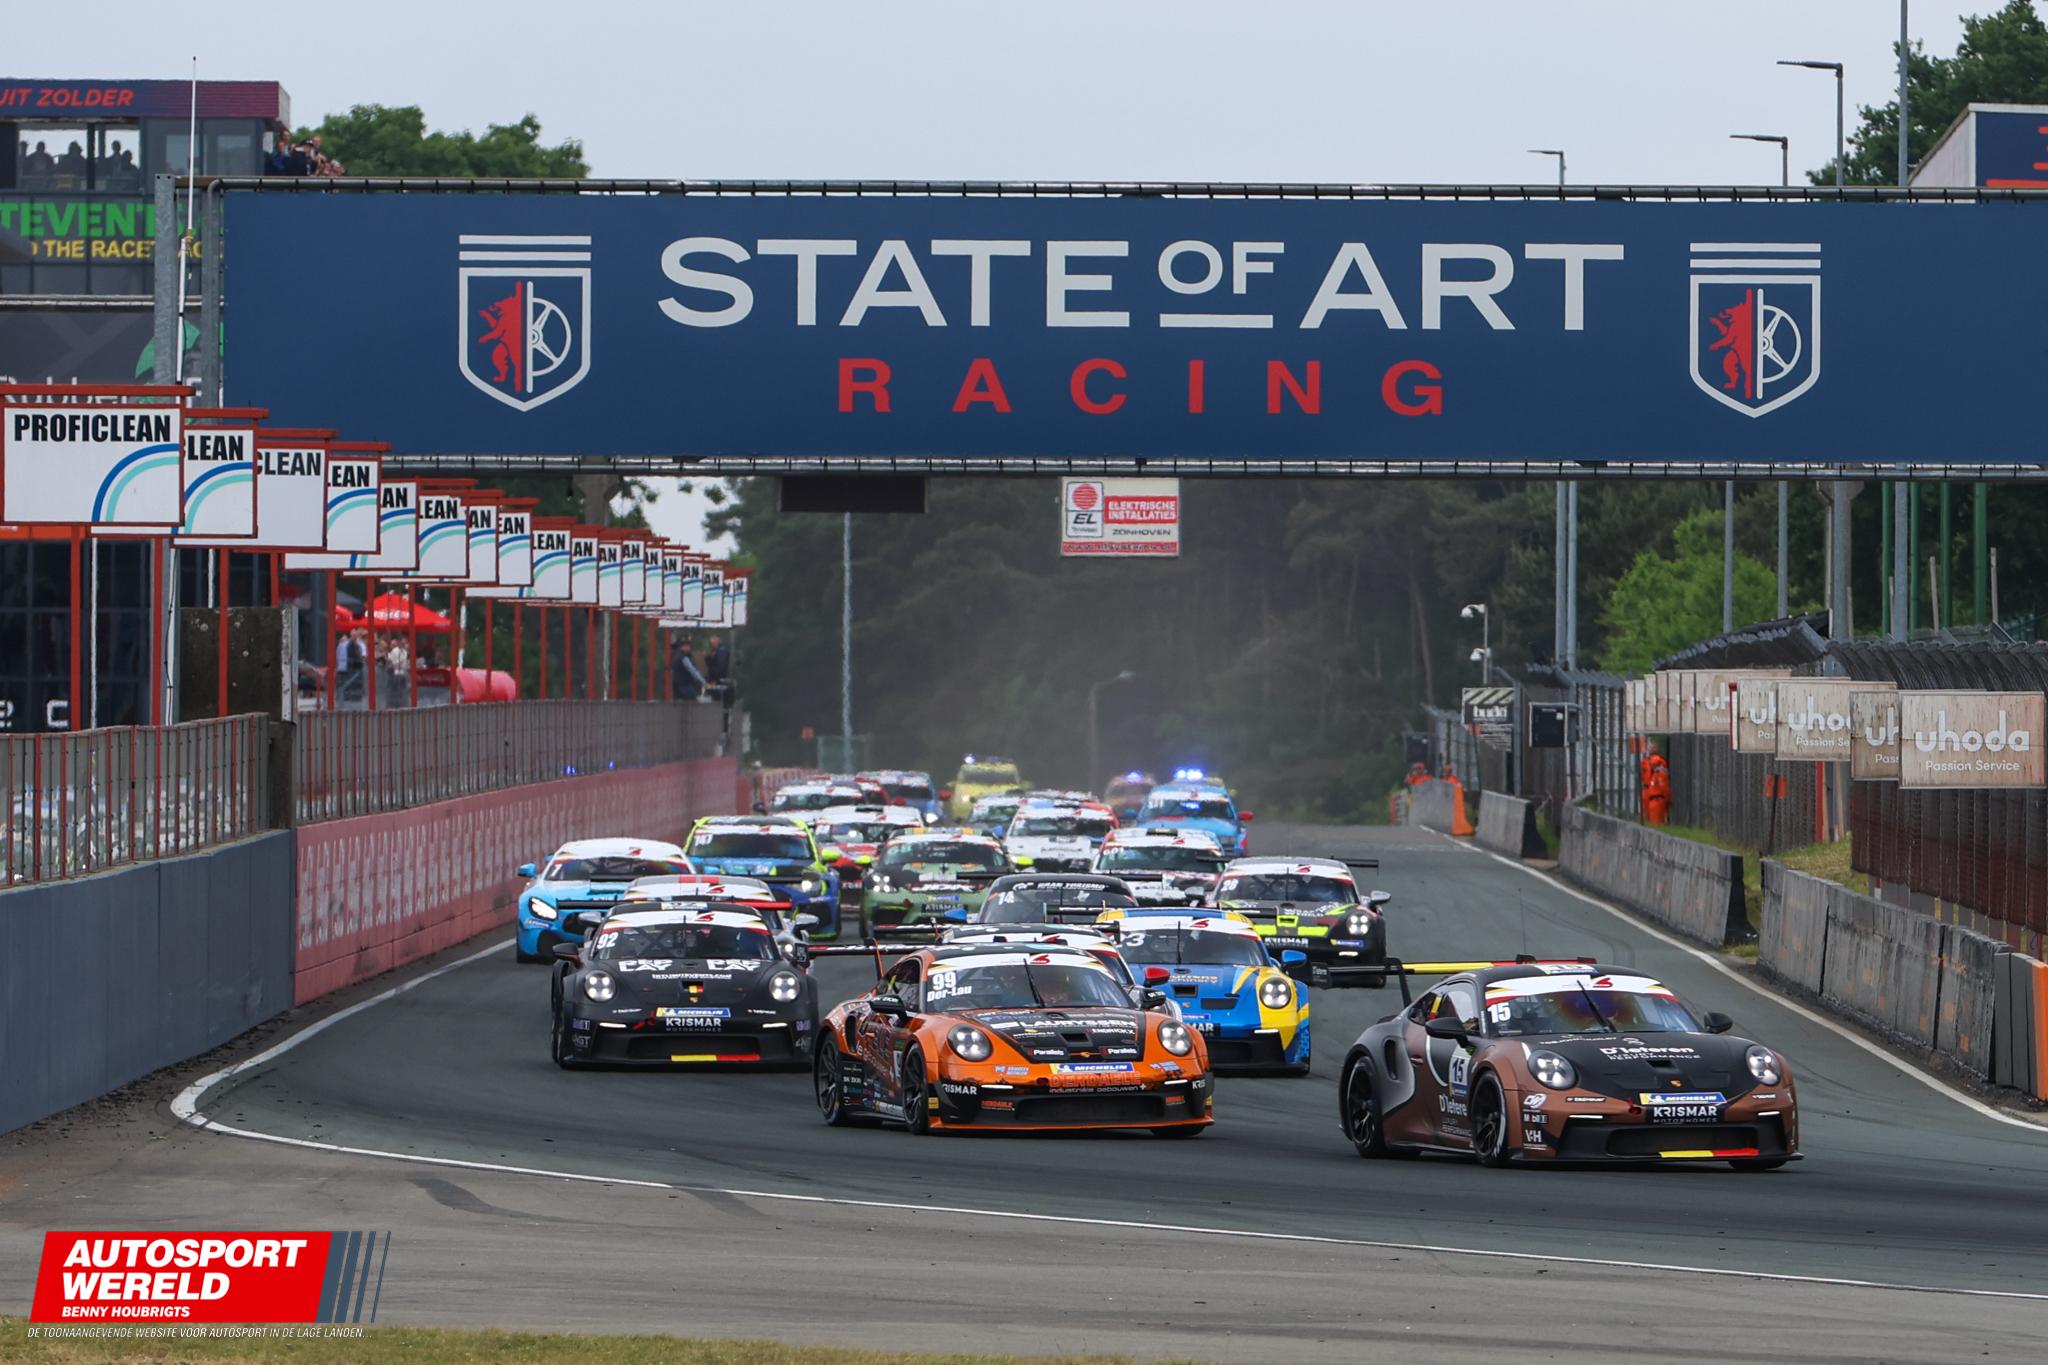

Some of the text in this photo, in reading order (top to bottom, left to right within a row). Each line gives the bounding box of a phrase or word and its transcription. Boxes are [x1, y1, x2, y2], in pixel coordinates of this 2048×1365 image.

[36, 88, 135, 106] ZOLDER
[45, 240, 84, 258] THE
[658, 236, 1625, 331] STATE OF ART
[838, 357, 1444, 417] RACING
[14, 413, 171, 443] PROFICLEAN
[184, 434, 244, 461] LEAN
[1108, 501, 1176, 511] ELEKTRISCHE
[1073, 513, 1097, 525] EL
[1108, 511, 1176, 520] INSTALLATIES
[1112, 528, 1171, 536] ZONHOVEN
[1788, 695, 1852, 731] uho
[1915, 710, 2030, 752] uhoda
[1796, 736, 1835, 747] Passion
[1925, 760, 2021, 771] Passion Service
[597, 931, 618, 949] 92
[932, 971, 957, 991] 99
[927, 986, 972, 1002] Dor-Lau
[1487, 1002, 1511, 1023] 15
[665, 1017, 721, 1027] KRISMAR
[1020, 1019, 1137, 1028] LAURYSSEN
[1452, 1058, 1465, 1083] 15
[942, 1083, 977, 1095] RISMAR
[1653, 1106, 1717, 1118] KRISMAR
